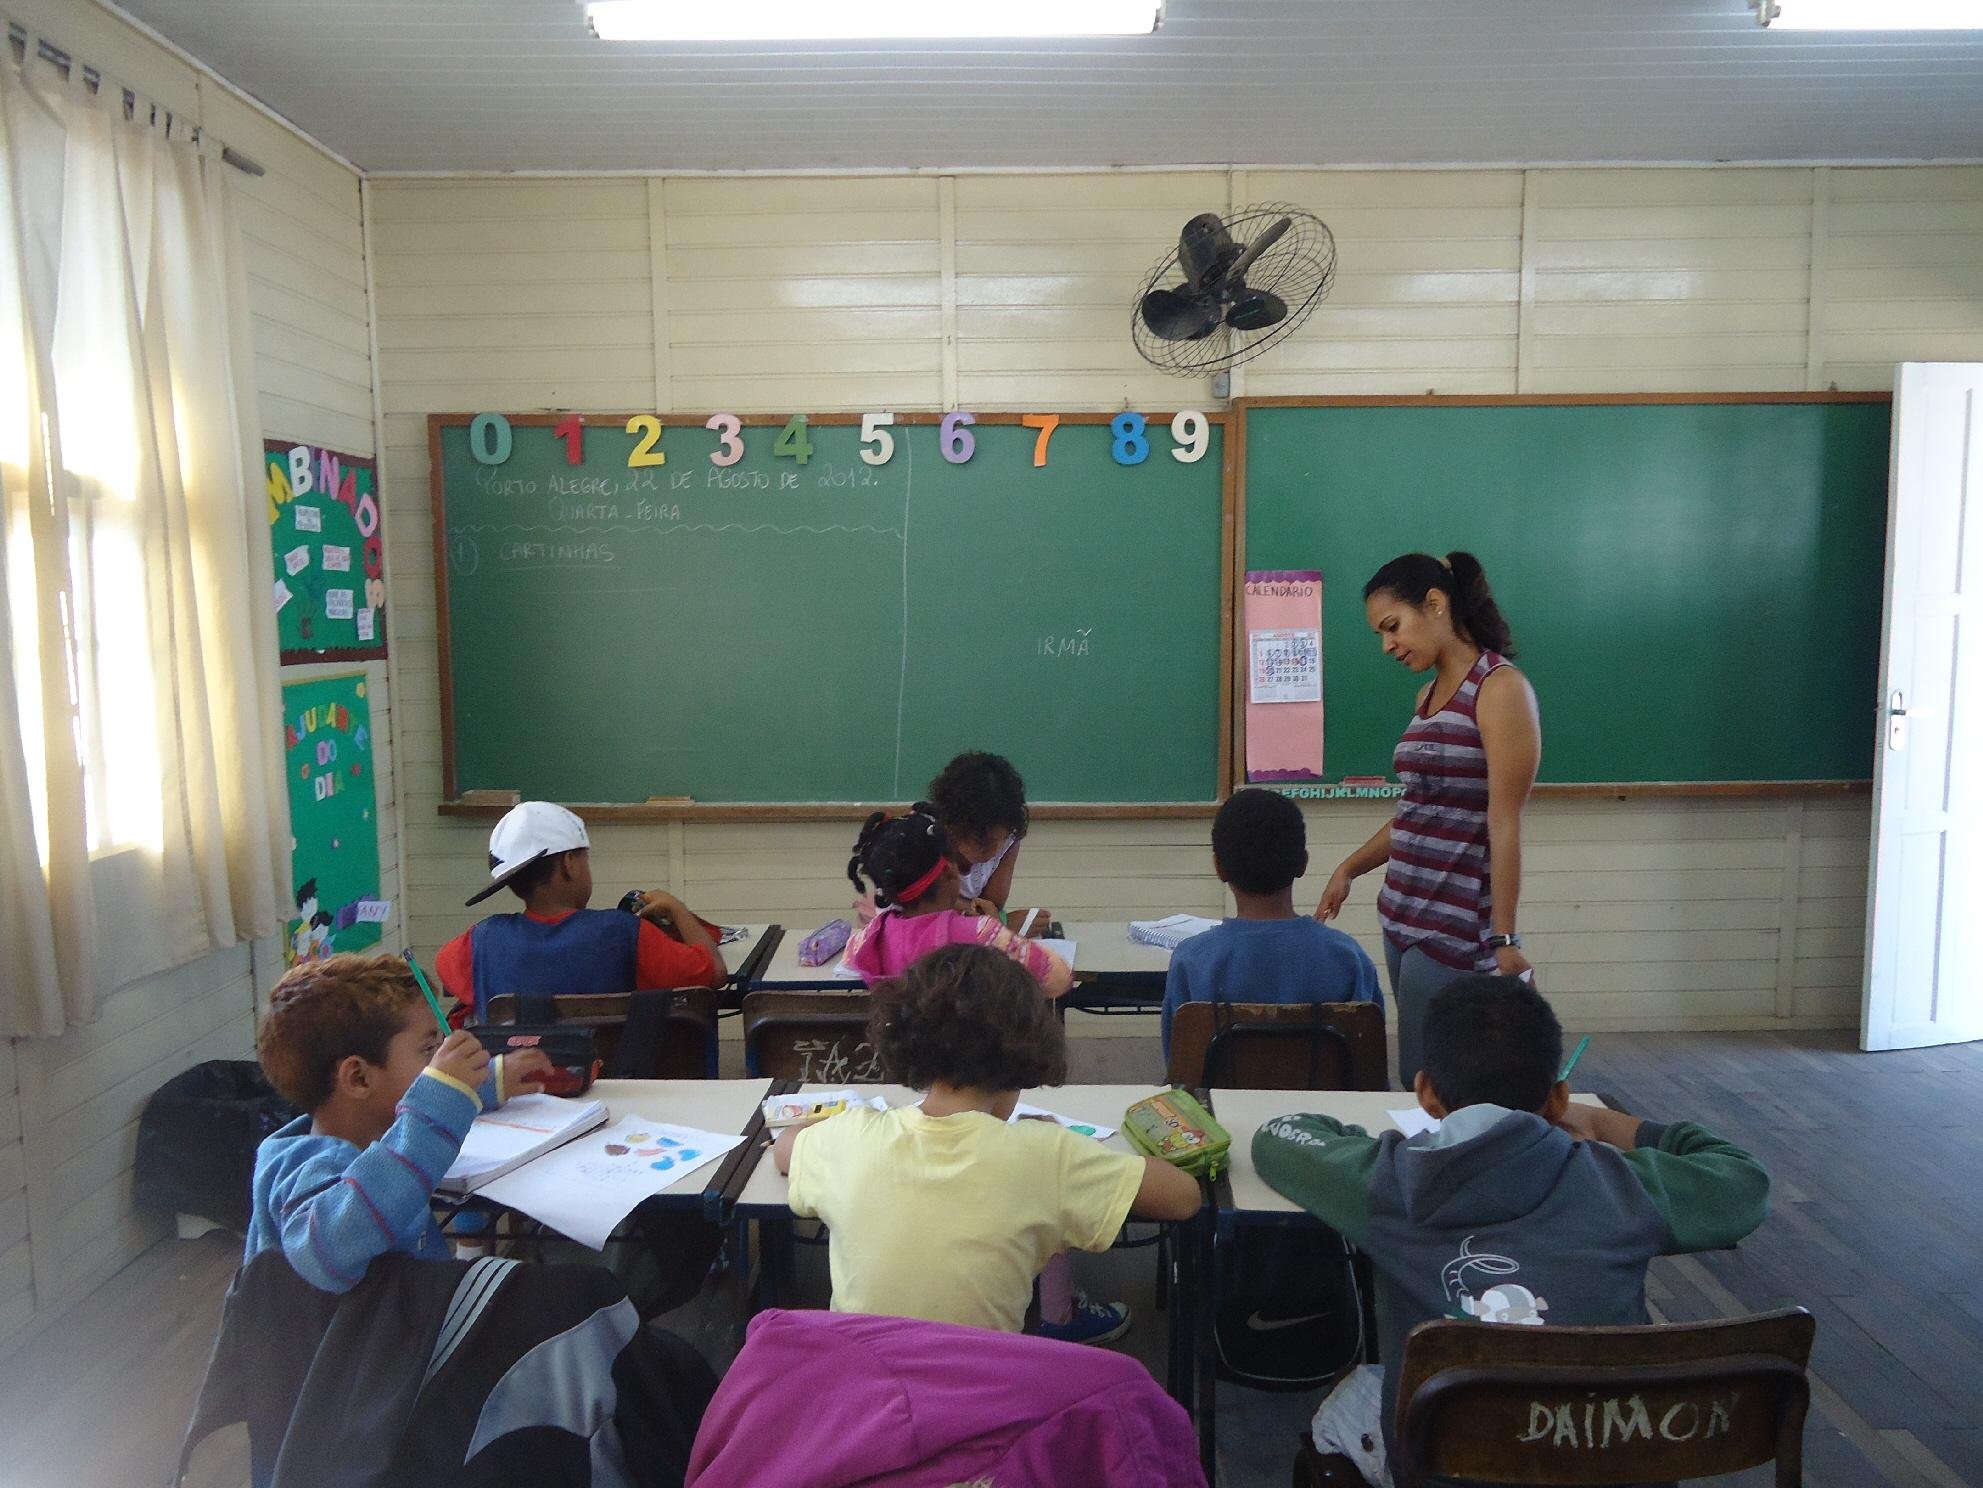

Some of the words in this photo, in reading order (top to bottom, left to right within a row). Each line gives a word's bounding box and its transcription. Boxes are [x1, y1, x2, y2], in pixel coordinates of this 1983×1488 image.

[470, 413, 512, 465] 0
[554, 414, 584, 465] 1
[626, 414, 666, 468] 2
[706, 413, 745, 467] 3
[774, 413, 814, 465] 4
[859, 412, 895, 466] 5
[940, 411, 976, 464] 6
[1022, 414, 1060, 467] 7
[1110, 411, 1150, 465] 8
[1171, 410, 1210, 464] 9
[547, 475, 619, 496] ALEGRE,
[626, 469, 658, 491] 22
[670, 469, 695, 490] DE
[707, 468, 770, 489] AGOSTO
[779, 471, 801, 490] DE
[817, 464, 880, 489] 2012.
[500, 543, 616, 563] CARTINHAS
[1037, 628, 1093, 657] IRMÃ
[314, 770, 346, 802] DIA
[1278, 787, 1408, 799] EFGHIJKLMNOP
